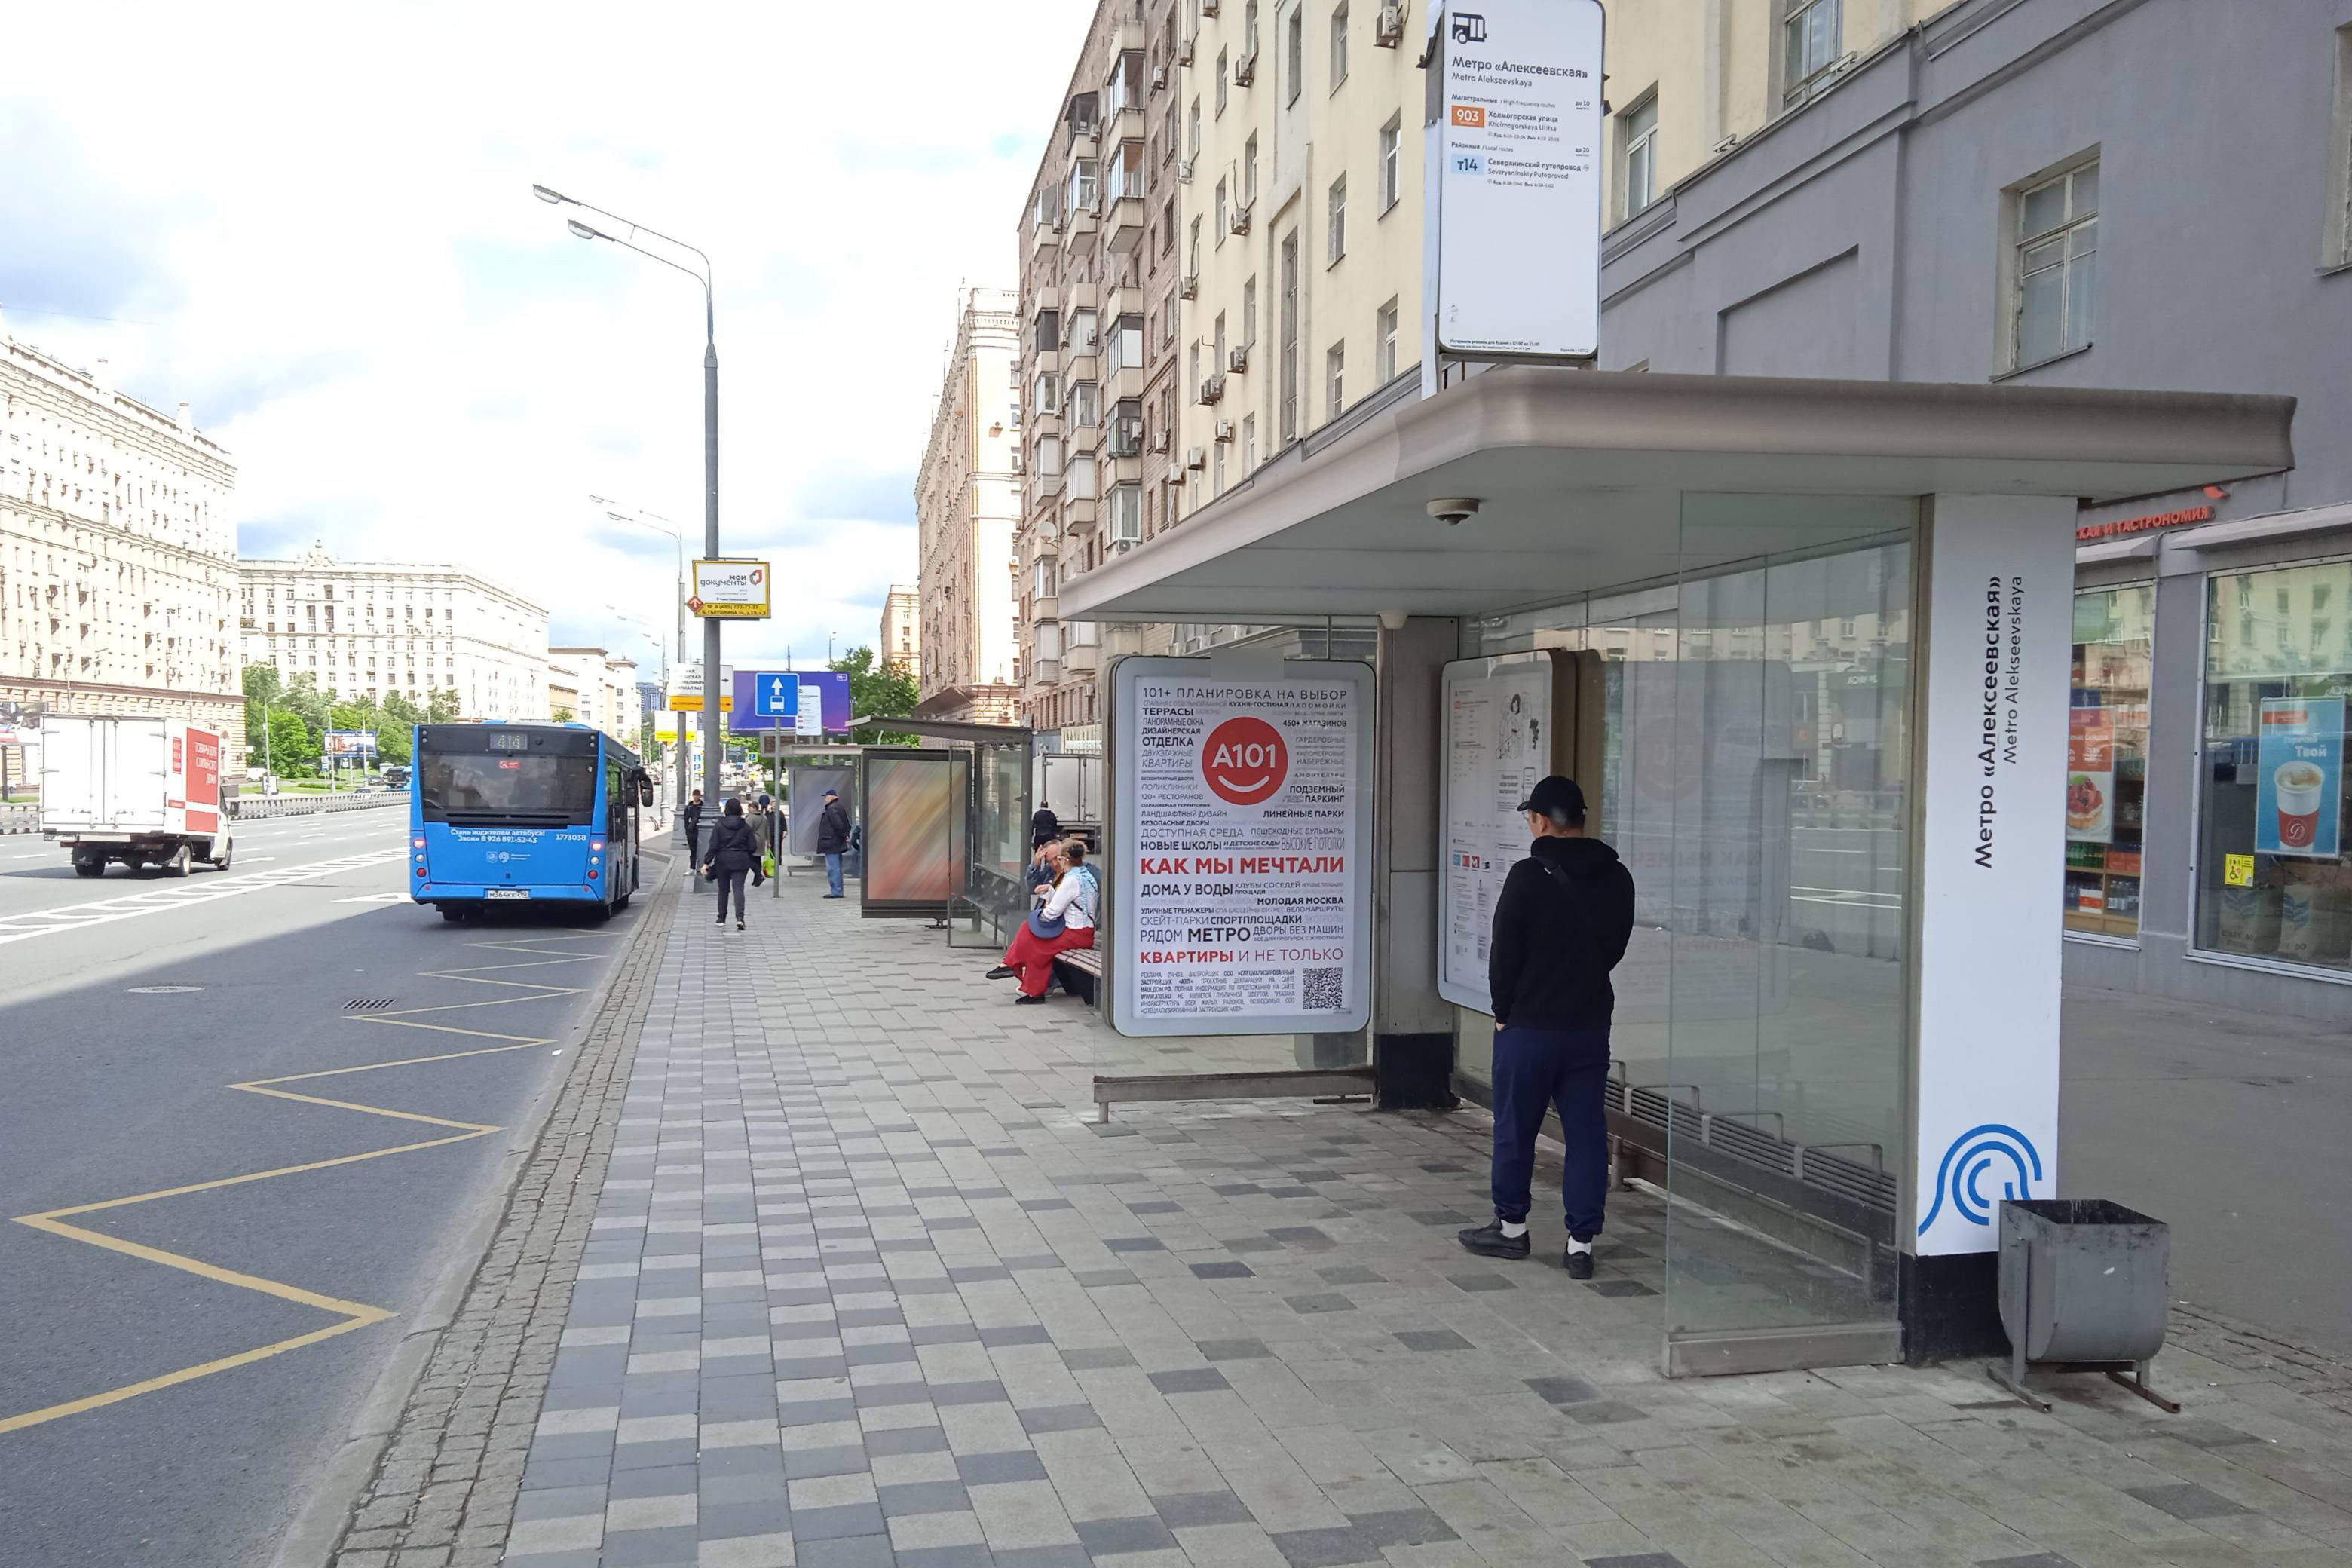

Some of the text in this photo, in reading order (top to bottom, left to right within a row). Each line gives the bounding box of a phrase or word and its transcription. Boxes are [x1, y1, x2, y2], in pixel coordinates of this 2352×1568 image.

[1452, 56, 1588, 79] Метро «Алексеевская»
[1452, 72, 1533, 88] Metro Alekseevskaya
[1452, 93, 1498, 104] Магистральные
[1456, 109, 1479, 122] 903
[1488, 110, 1536, 121] Холмогорская
[1488, 121, 1538, 131] Kholmogorskaya
[1451, 141, 1480, 150] Районные
[1457, 158, 1478, 172] т14
[1487, 158, 1582, 172] Северянинский путепровод
[1488, 168, 1569, 179] Severyaninskiy Puteprovod
[2077, 506, 2210, 541] КАЯ И ГАСТРОНОМИЯ
[700, 580, 747, 588] документы
[2003, 576, 2026, 764] Metro Alekseevskaya
[1143, 688, 1347, 701] 101+ ПЛАНИРОВКА НА ВЫБОР
[1142, 707, 1193, 716] ТЕРРАСЫ
[1143, 717, 1204, 726] ПАНОРАМНЫЕ ОКНА
[1974, 576, 2001, 868] Метро «Алексеевская»
[1141, 726, 1201, 735] ДИЗАЙНЕРСКАЯ
[497, 735, 519, 749] 414
[1142, 737, 1194, 748] ОТДЕЛКА
[1211, 743, 1276, 769] А101
[2295, 744, 2327, 757] Твой
[1142, 758, 1193, 768] КВАРТИРЫ
[1290, 784, 1345, 795] ПОДЗЕМНЫЙ
[1305, 795, 1345, 803] ПАРКИНГ
[1199, 810, 1227, 818] ДИЗАЙН
[1263, 809, 1312, 818] ЛИНЕЙНЫЕ
[1141, 828, 1244, 838] ДОСТУПНАЯ СРЕДА
[1141, 841, 1222, 850] НОВЫЕ ШКОЛЫ
[1282, 837, 1345, 850] ВЫСОКИЕ ПОТОЛКИ
[1141, 856, 1344, 874] КАК МЫ МЕЧТАЛИ
[1141, 884, 1233, 897] ДОМА У ВОДЫ
[1257, 897, 1304, 906] МОЛОДАЯ
[1141, 914, 1209, 926] СКЕЙТ-ПАРКИ
[1210, 915, 1302, 925] СПОРТПЛОЩАДКИ
[1141, 927, 1251, 945] РЯДОМ МЕТРО
[1253, 925, 1344, 936] ДВОРЫ БЕЗ МАШИН
[1141, 950, 1233, 964] КВАРТИРЫ
[1239, 950, 1249, 962] И
[1255, 949, 1276, 962] НЕ
